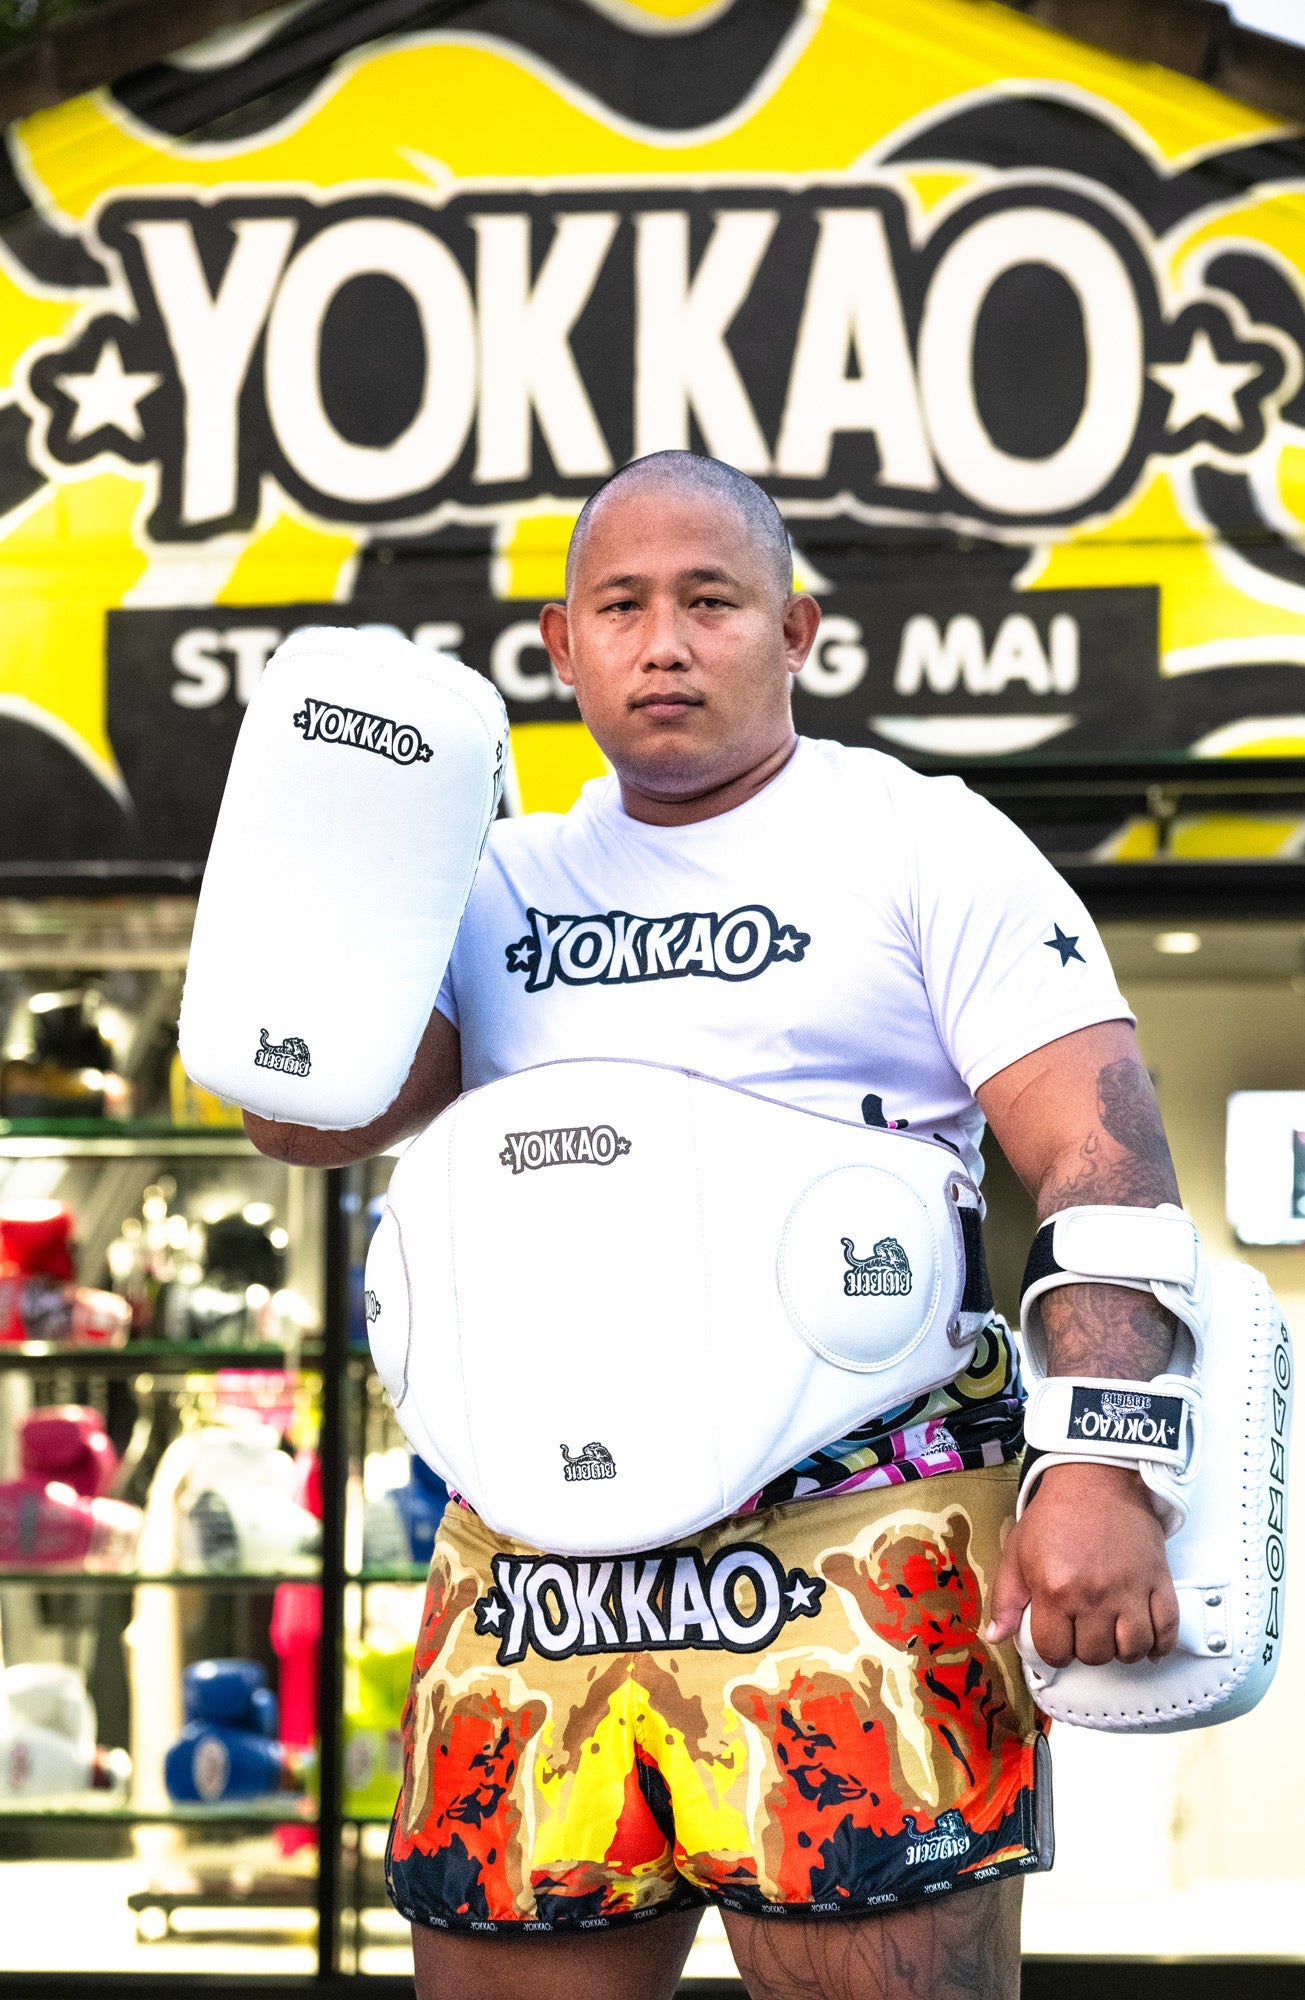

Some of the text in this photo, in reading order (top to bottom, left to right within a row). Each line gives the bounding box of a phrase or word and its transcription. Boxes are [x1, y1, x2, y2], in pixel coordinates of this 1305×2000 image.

[128, 204, 1143, 524] YOKKAO
[894, 612, 1081, 696] MAI
[304, 699, 421, 764] YOKKAO
[527, 906, 777, 991] YOKKAO
[507, 1126, 617, 1172] YOKKAO
[844, 1265, 912, 1296] มวยไทย
[1081, 1411, 1169, 1445] YOKKAO
[1264, 1343, 1292, 1641] YOKKAO
[497, 1549, 781, 1657] YOKKAO
